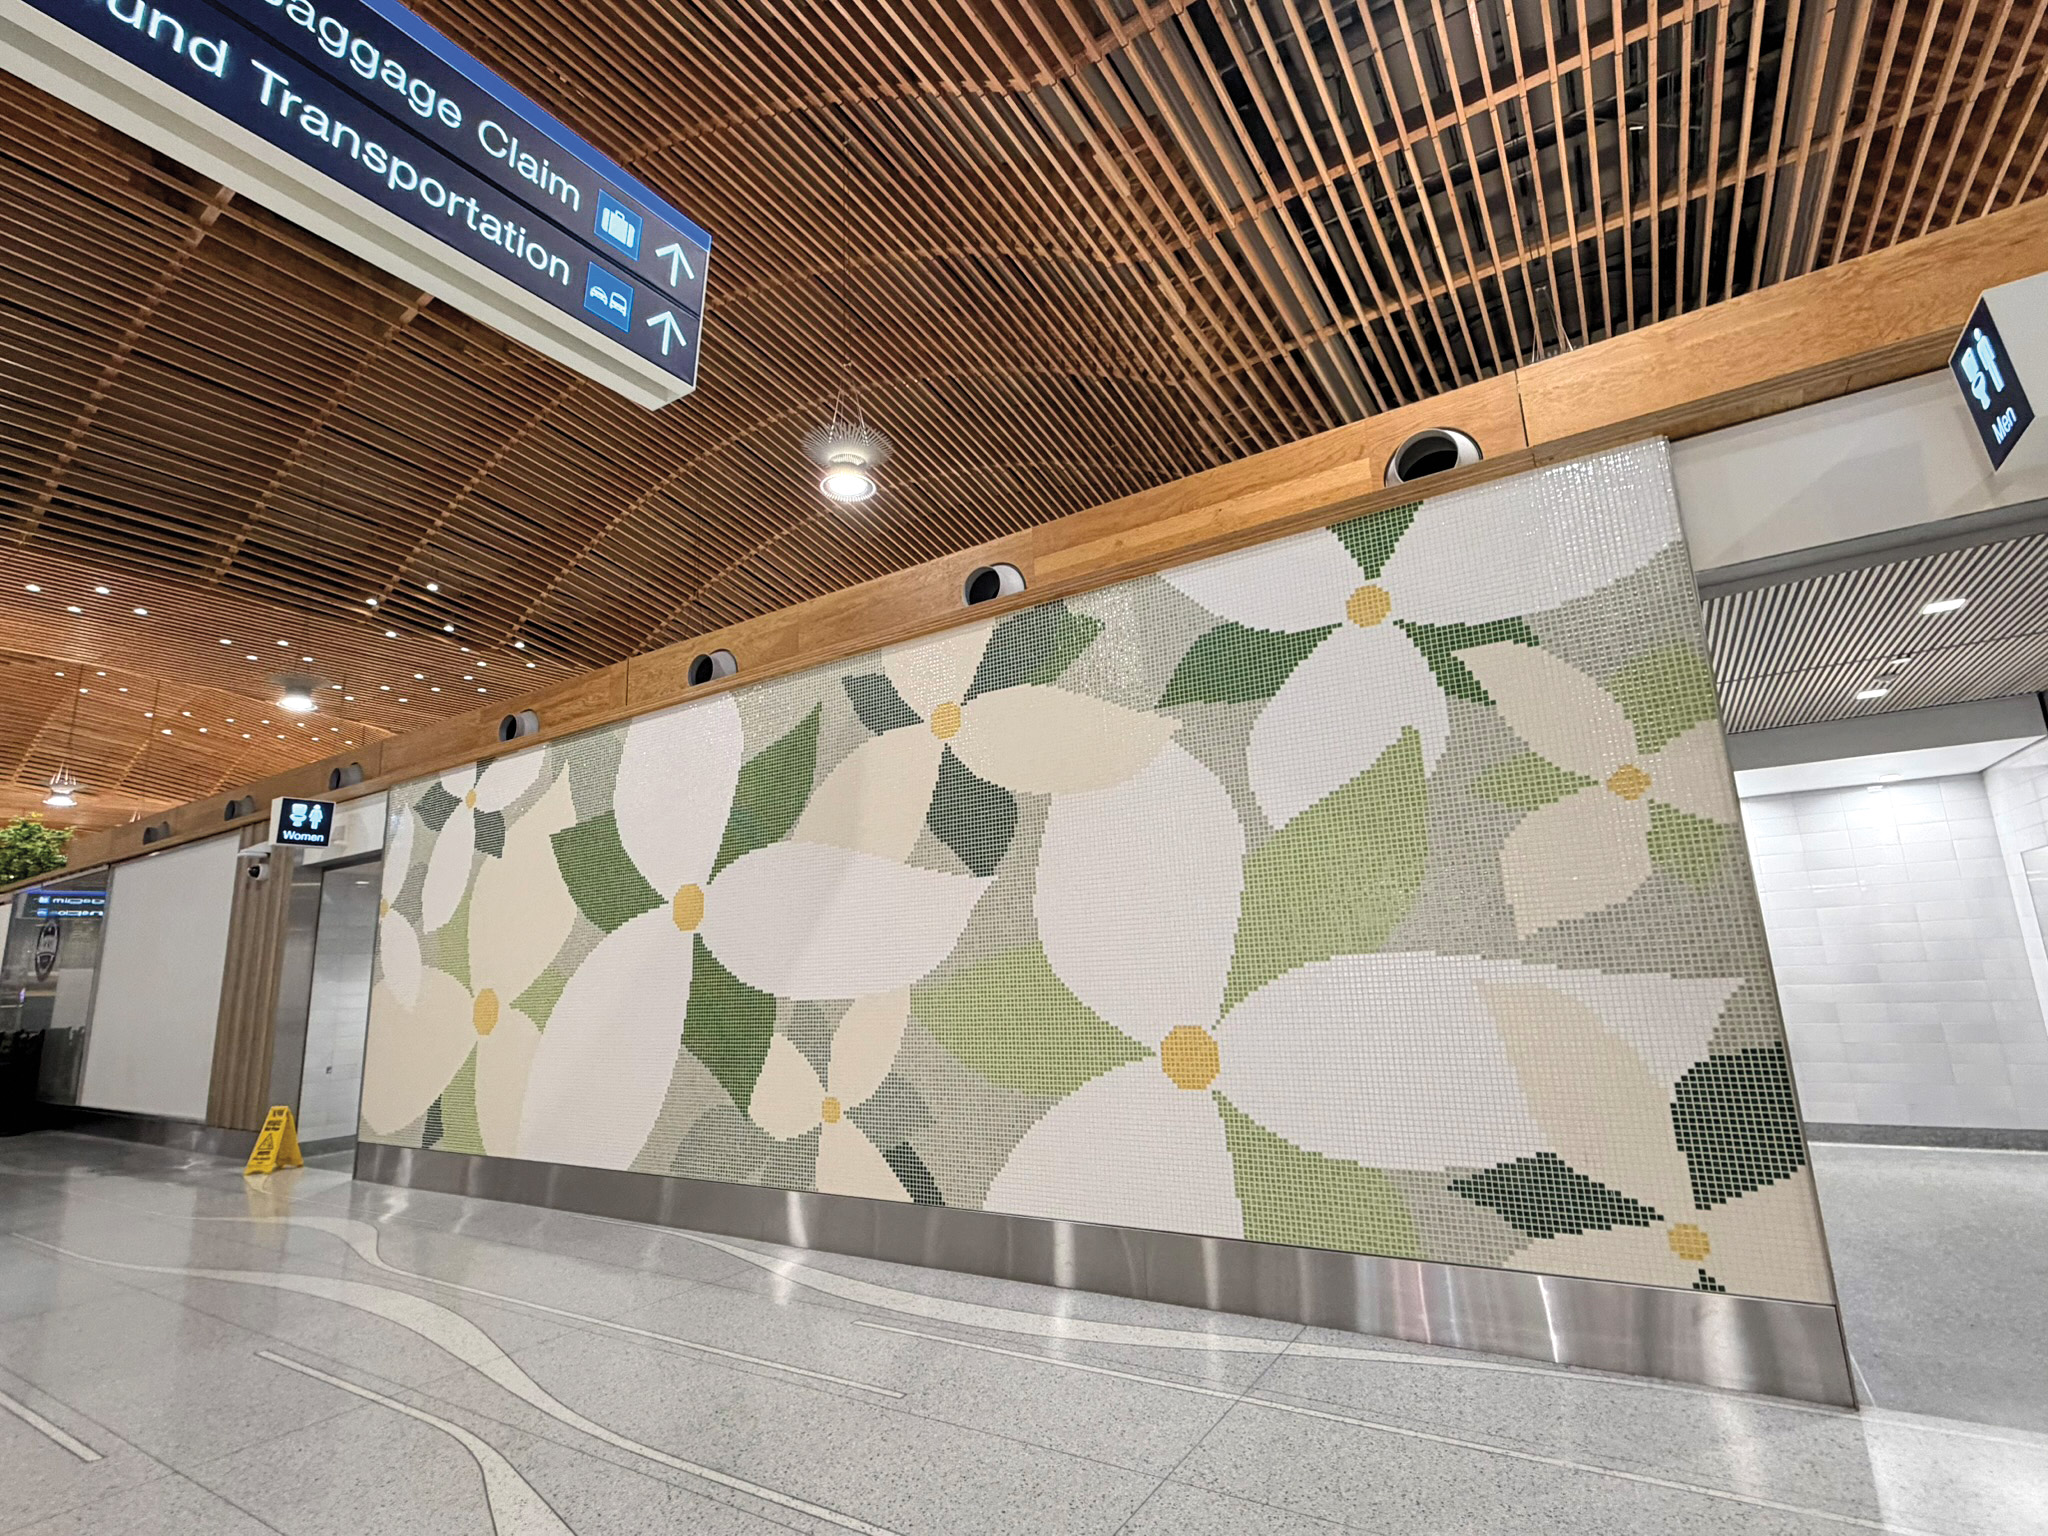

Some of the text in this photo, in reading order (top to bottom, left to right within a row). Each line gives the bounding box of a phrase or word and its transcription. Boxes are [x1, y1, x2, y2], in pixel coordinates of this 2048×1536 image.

[106, 0, 570, 287] und Transportation
[264, 0, 581, 213] aggage Claim
[1991, 406, 2018, 445] Men
[282, 830, 325, 843] Women
